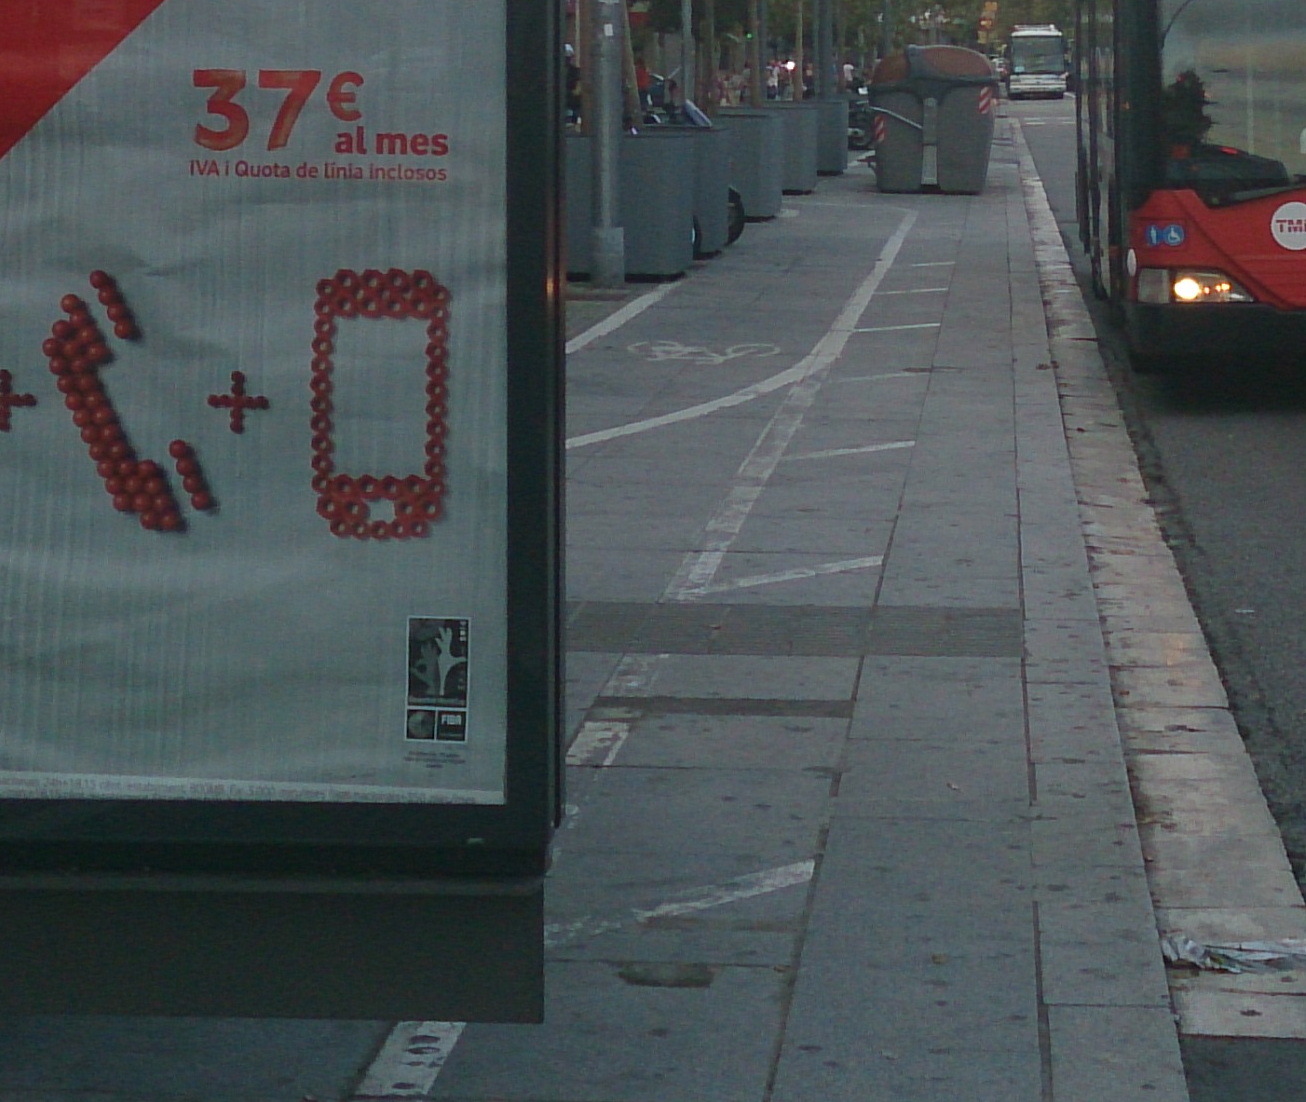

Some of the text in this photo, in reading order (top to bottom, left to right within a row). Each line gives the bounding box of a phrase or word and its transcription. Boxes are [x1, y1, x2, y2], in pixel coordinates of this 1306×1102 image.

[192, 68, 365, 152] 37€
[334, 125, 449, 156] al mes
[190, 159, 220, 177] IVA
[234, 160, 291, 179] Quota
[295, 161, 319, 179] de
[368, 162, 448, 182] inclosos
